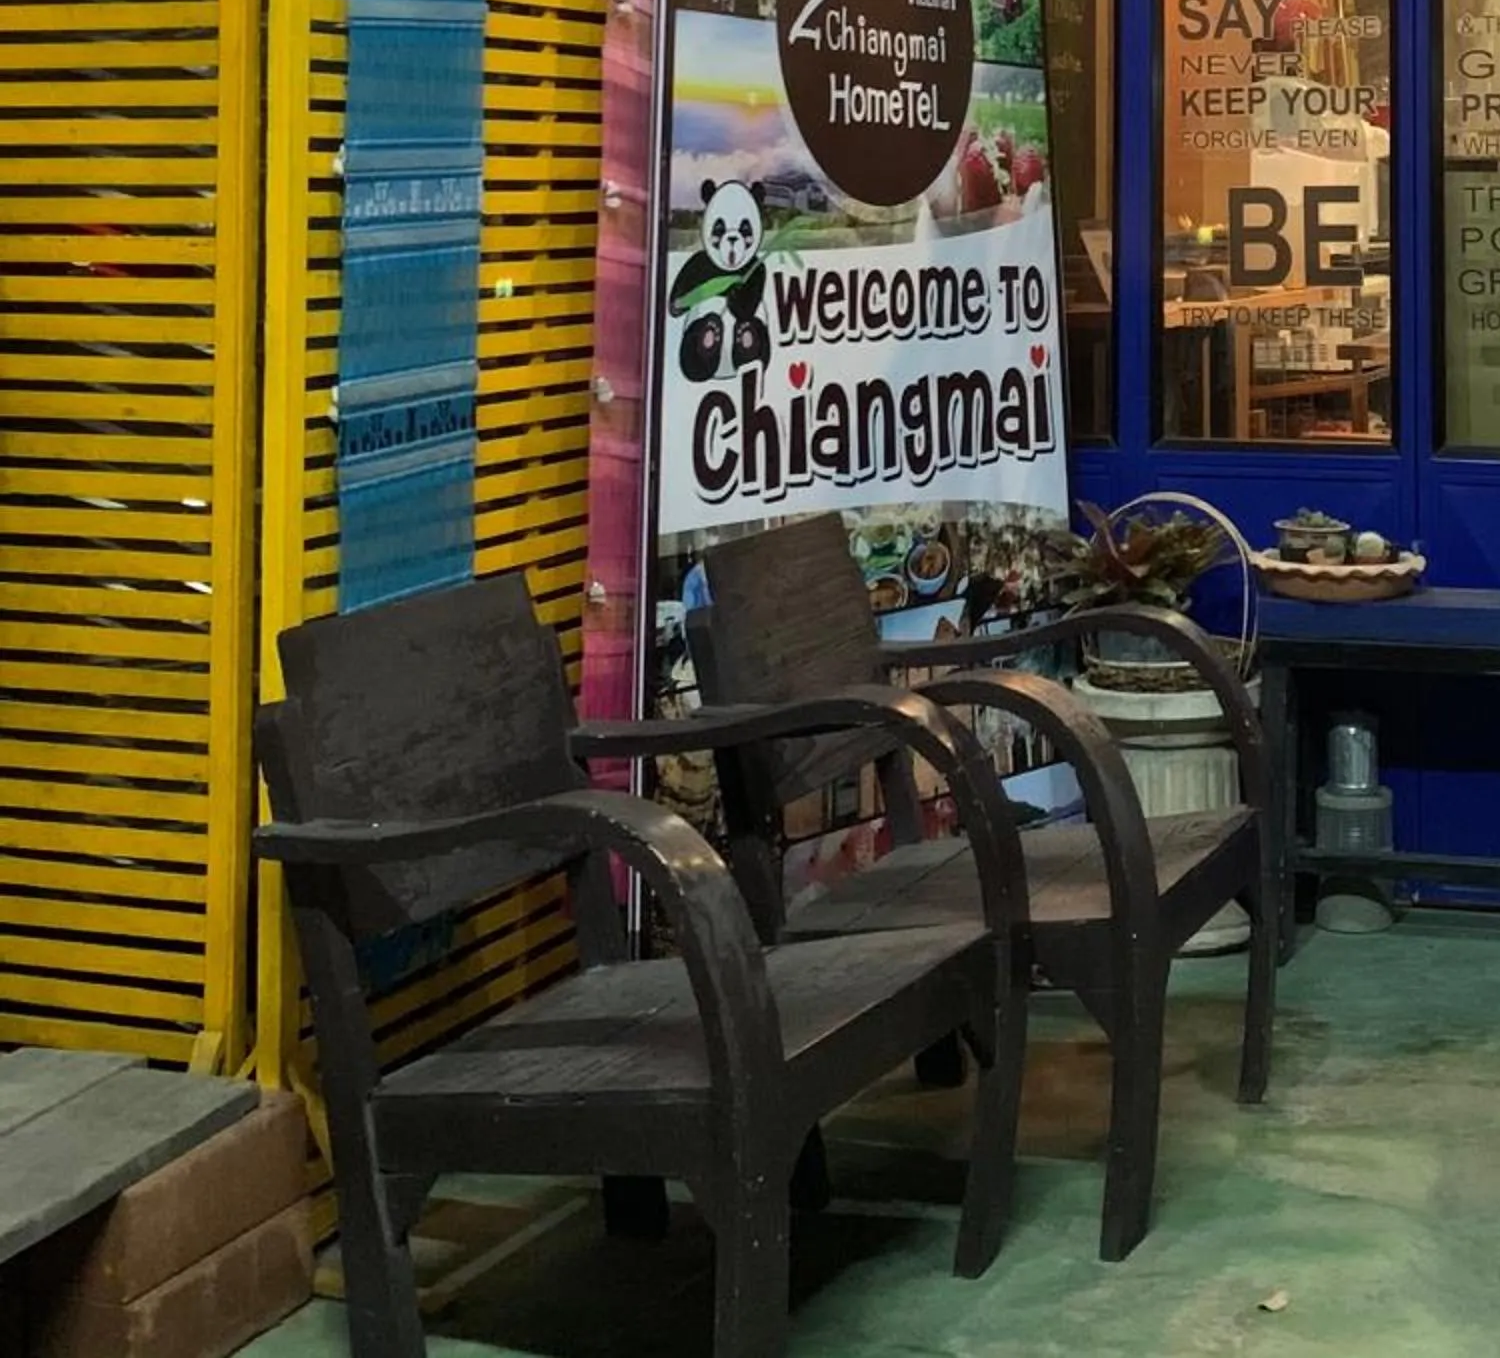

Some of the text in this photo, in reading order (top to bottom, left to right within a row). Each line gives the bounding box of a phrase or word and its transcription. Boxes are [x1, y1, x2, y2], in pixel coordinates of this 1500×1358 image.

[1291, 17, 1377, 37] PLEASE
[825, 8, 947, 77] Chiangmai
[1181, 54, 1303, 76] NEVER
[1181, 87, 1378, 117] KEEP YOUR
[1181, 129, 1358, 150] FORGIVE EVEN
[1228, 186, 1364, 287] BE
[1180, 306, 1386, 329] TRY TO KEEP THESE
